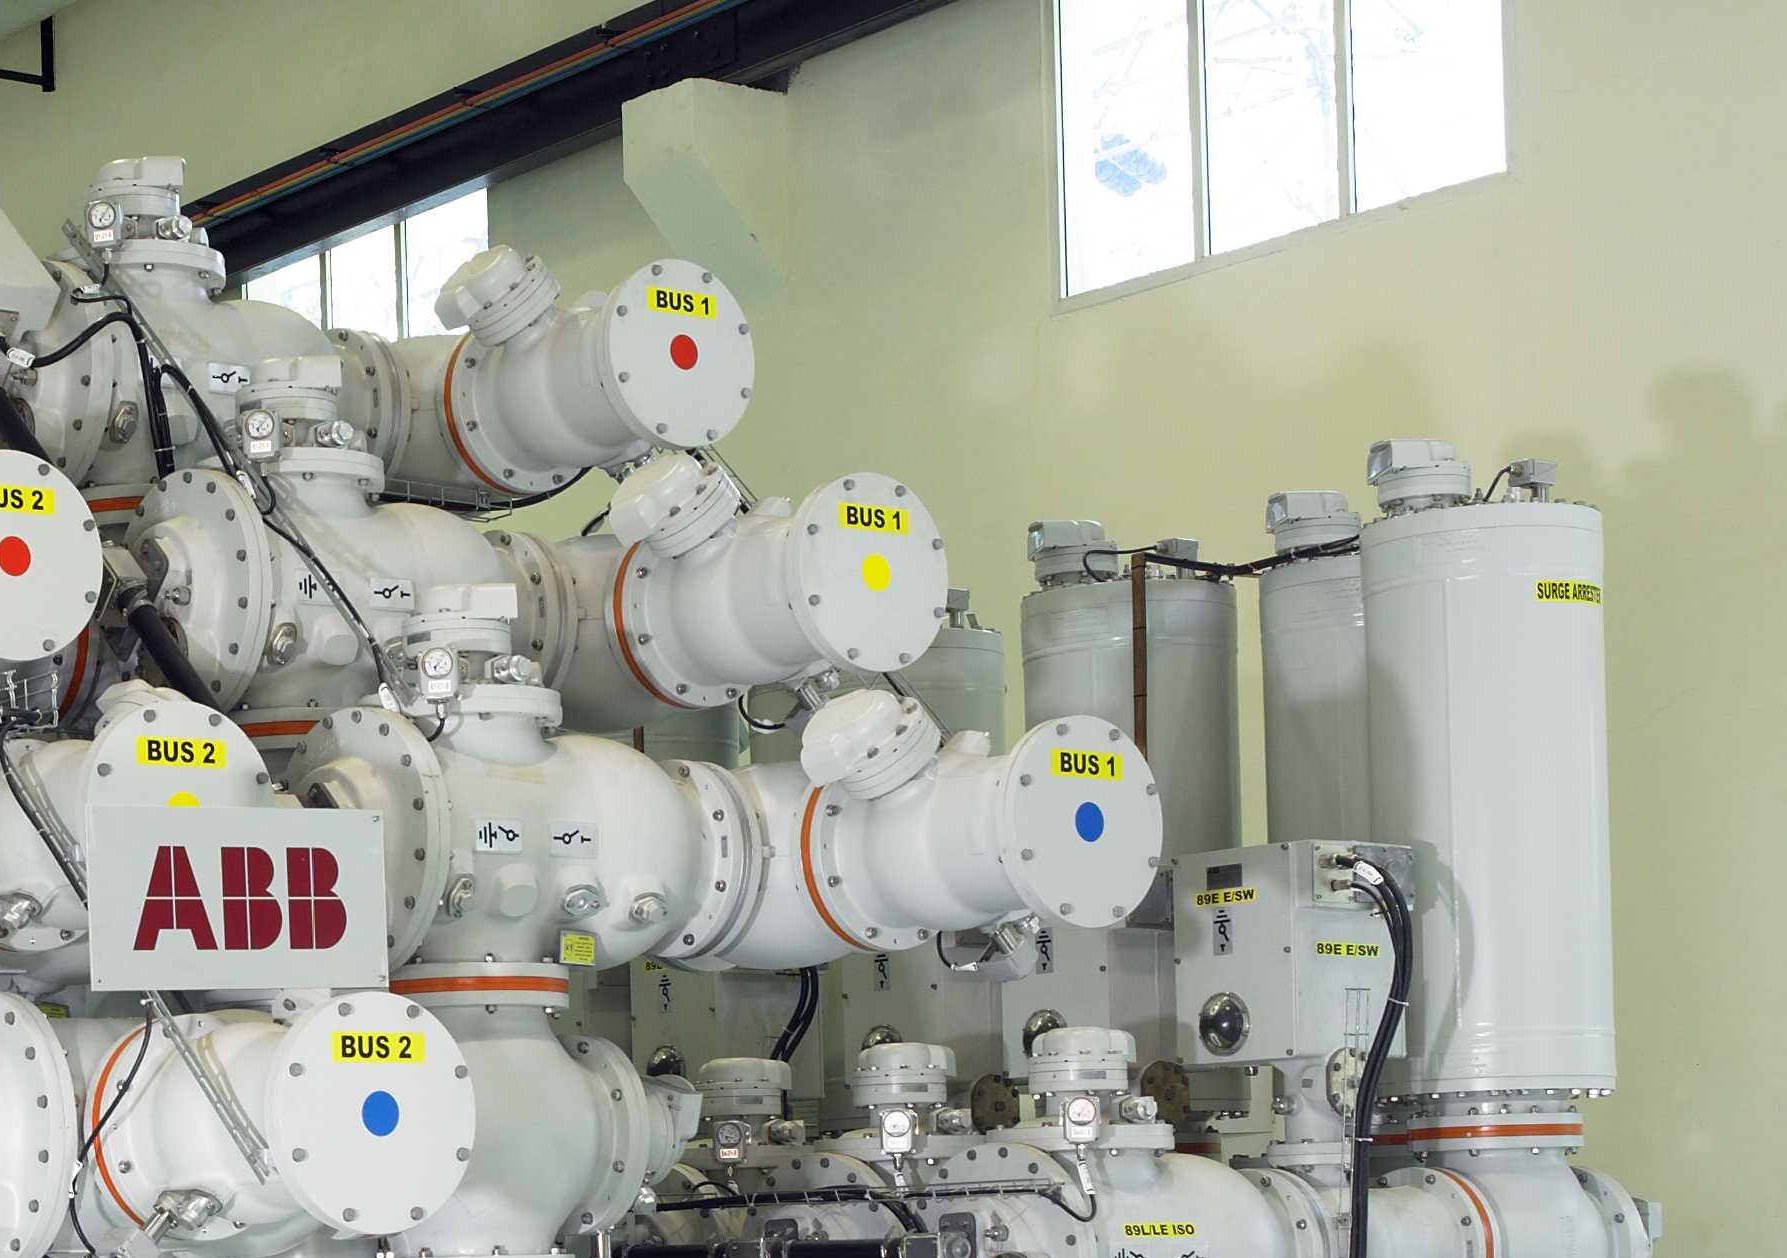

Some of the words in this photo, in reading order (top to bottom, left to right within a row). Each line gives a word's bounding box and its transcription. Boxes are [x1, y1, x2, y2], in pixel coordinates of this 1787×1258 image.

[655, 290, 696, 313] BUS
[701, 296, 710, 315] 1
[32, 490, 44, 510] 2
[846, 505, 886, 529] BUS
[893, 510, 902, 531] 1
[1537, 582, 1570, 599] SURGE
[147, 740, 194, 763] BUS
[203, 743, 215, 764] 2
[1060, 752, 1099, 775] BUS
[1107, 757, 1115, 777] 1
[133, 846, 347, 951] ABB
[1196, 891, 1220, 906] 89E
[1223, 889, 1255, 903] E/SW
[1316, 943, 1342, 955] 89E
[1346, 945, 1379, 957] E/SW
[340, 1035, 390, 1058] BUS
[399, 1036, 412, 1058] 2
[1124, 1224, 1168, 1236] 89L/LE
[1172, 1223, 1195, 1235] ISO
